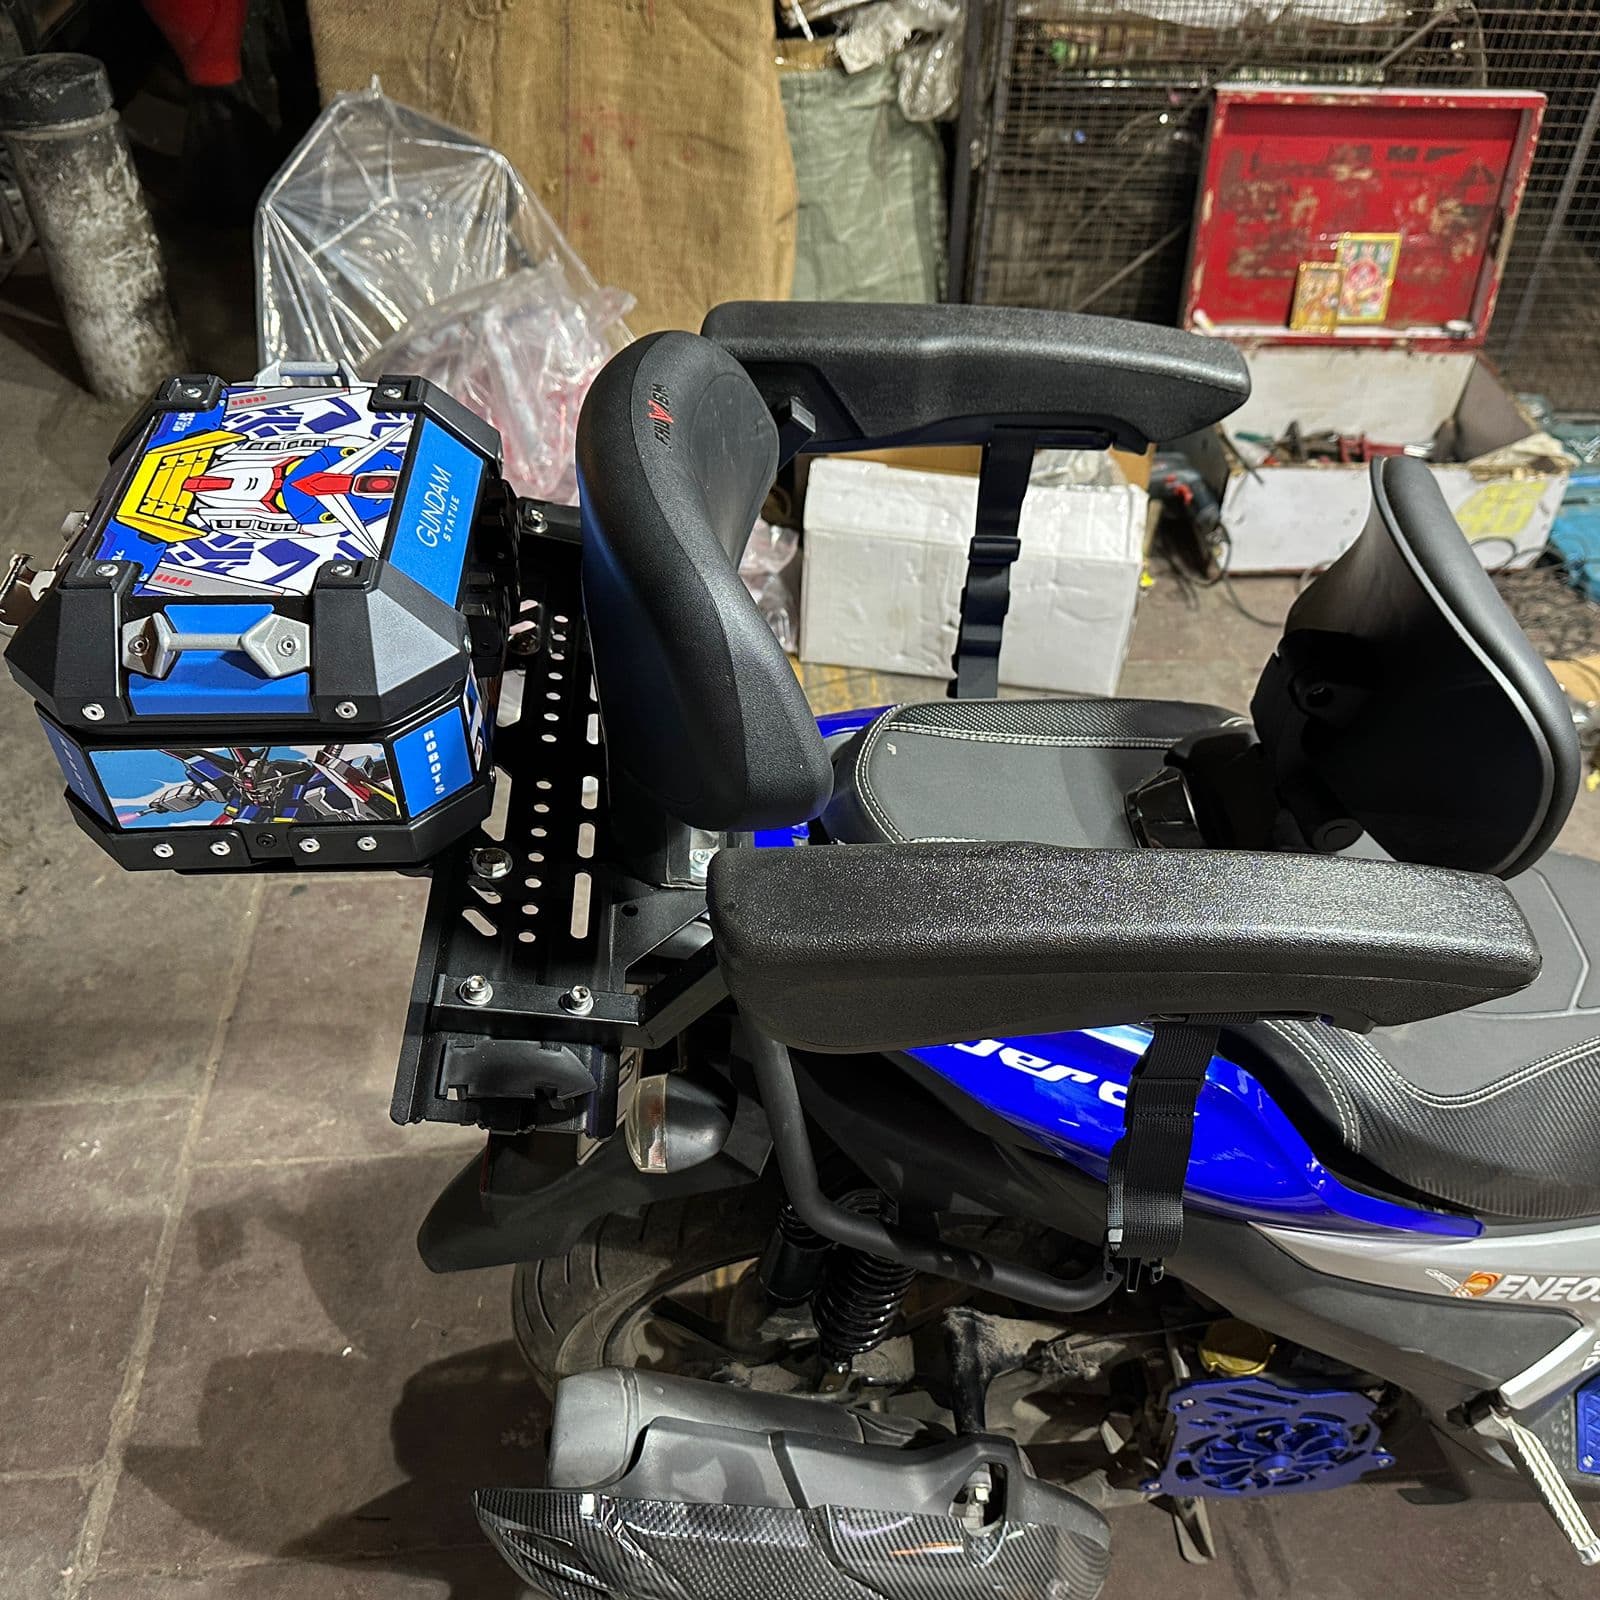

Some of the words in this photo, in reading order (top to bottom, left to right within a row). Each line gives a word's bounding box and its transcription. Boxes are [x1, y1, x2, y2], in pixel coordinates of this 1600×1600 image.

[416, 463, 452, 548] GUNDAM
[443, 494, 460, 542] STATUE
[423, 729, 446, 795] ROBOTS
